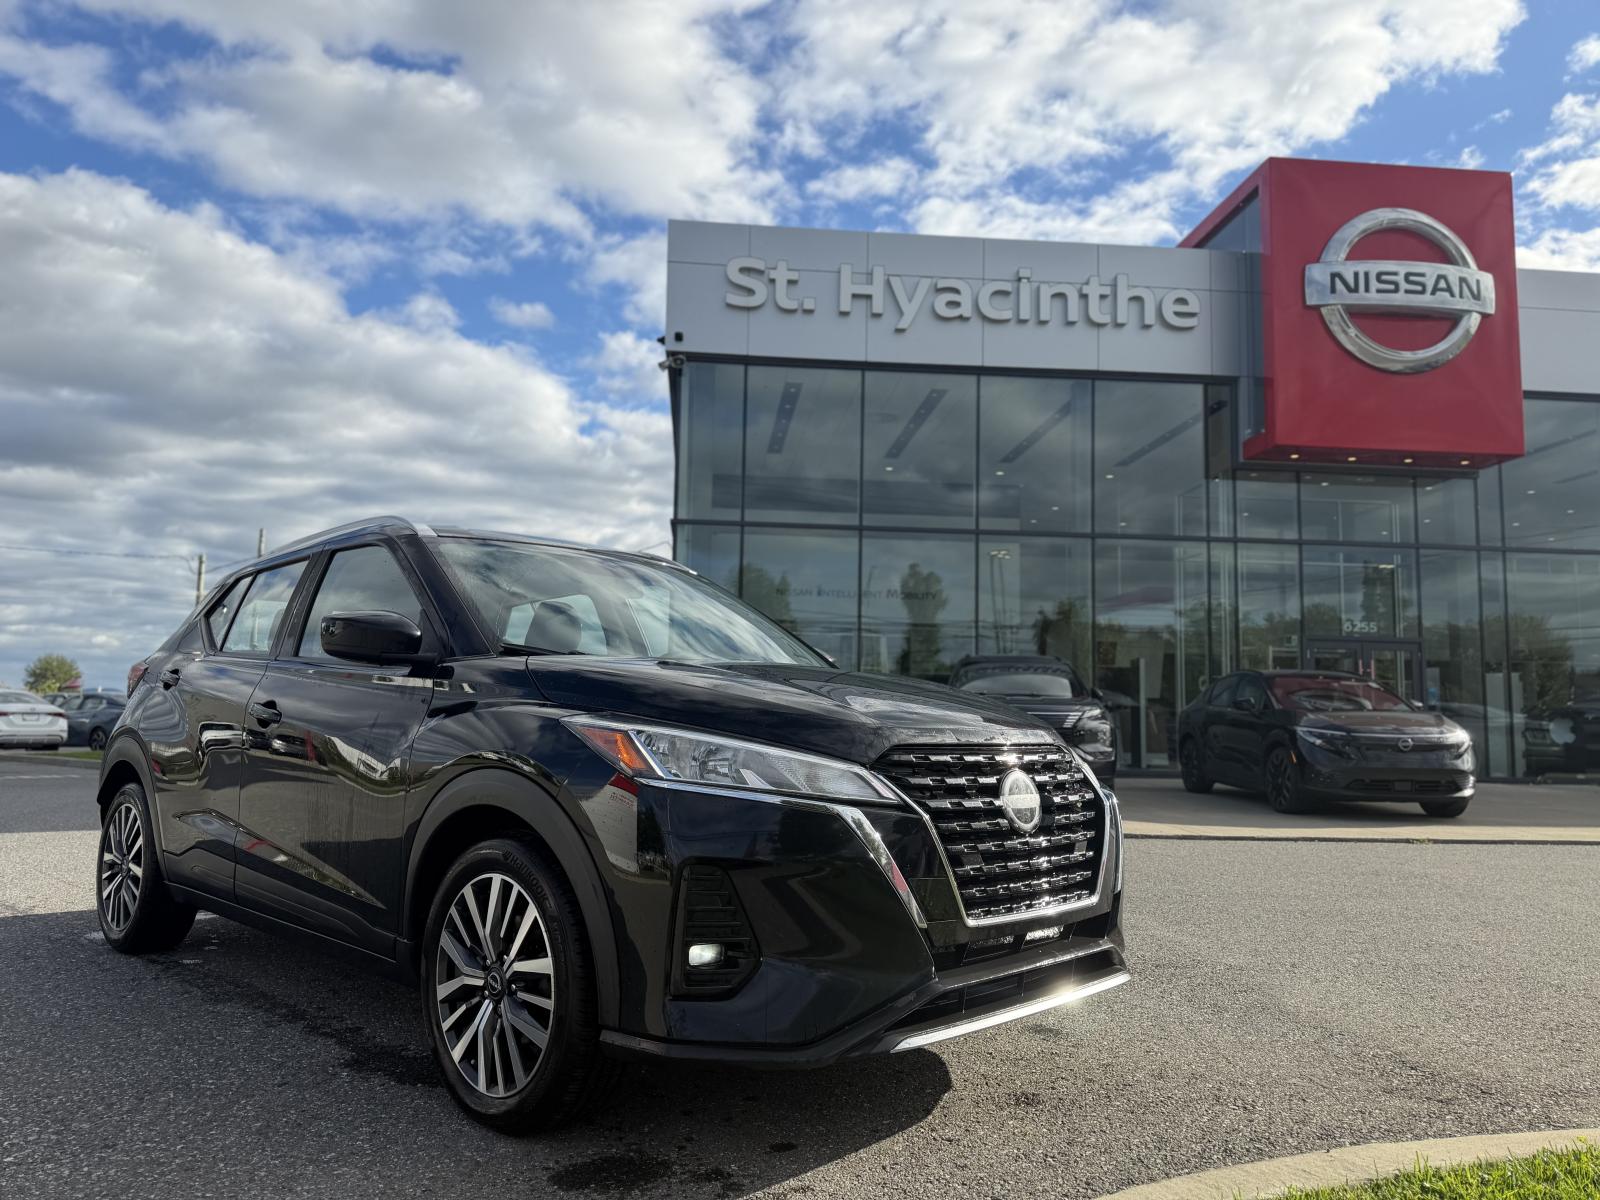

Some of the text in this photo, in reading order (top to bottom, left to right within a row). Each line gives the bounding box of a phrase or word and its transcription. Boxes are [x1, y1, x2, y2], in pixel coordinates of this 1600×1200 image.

[724, 256, 1200, 333] St. Hyacinthe
[1329, 270, 1482, 302] NISSAN
[775, 587, 813, 597] NISAN
[1343, 620, 1378, 633] 6255
